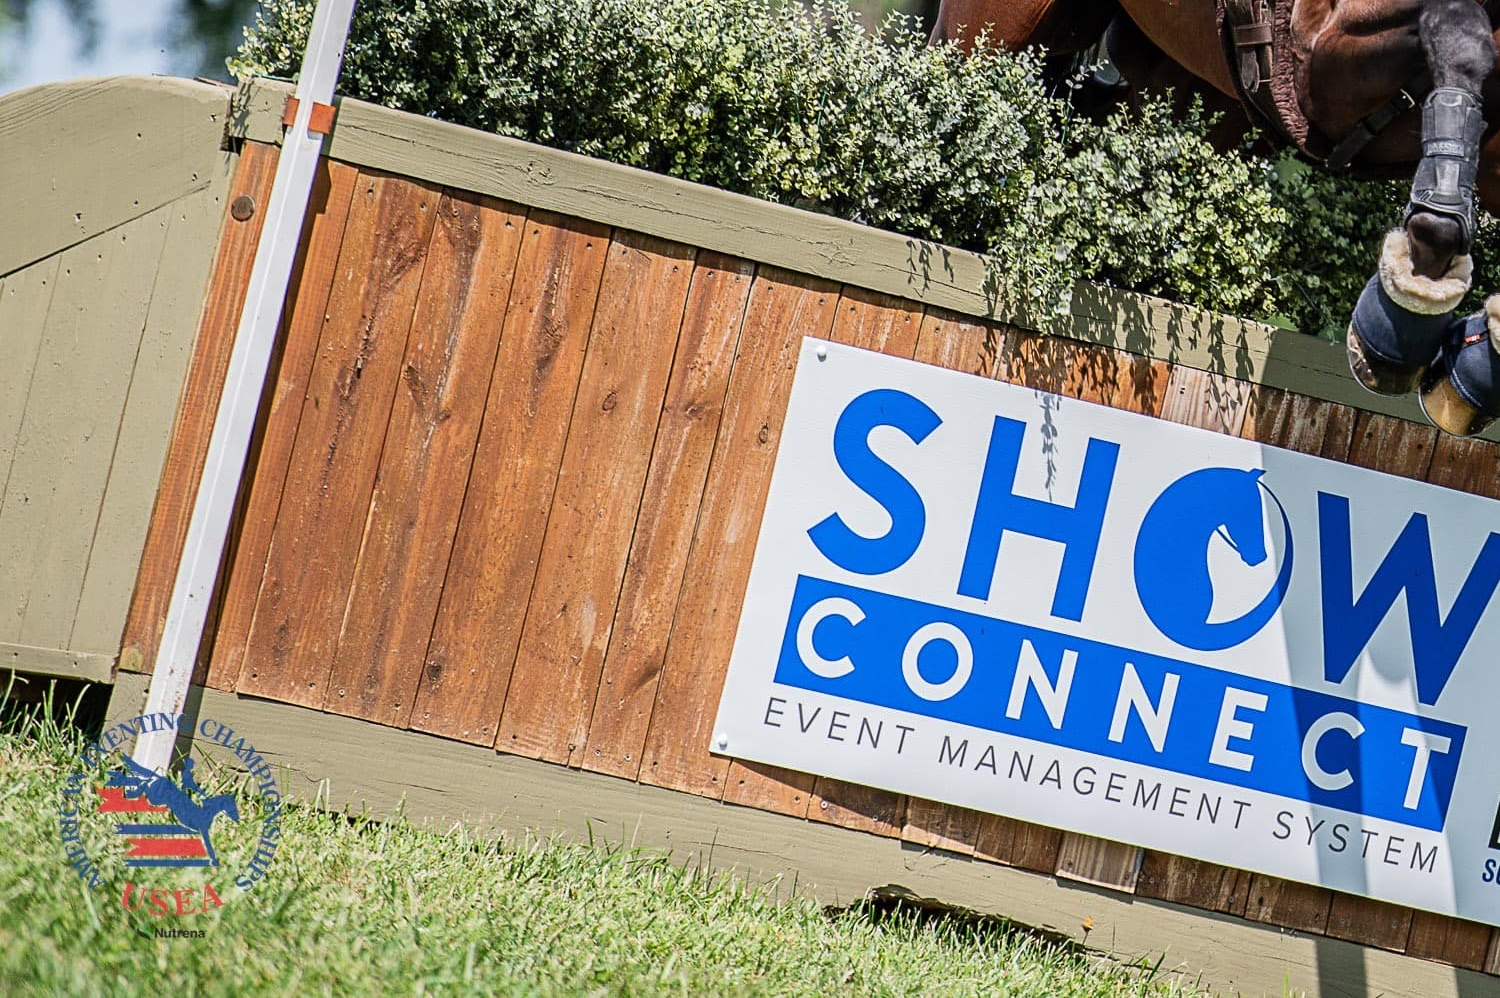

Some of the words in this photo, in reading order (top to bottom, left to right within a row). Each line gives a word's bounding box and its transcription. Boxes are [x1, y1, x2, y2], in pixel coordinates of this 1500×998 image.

[763, 697, 917, 756] EVENT
[938, 735, 1251, 830] MANAGEMENT
[1274, 810, 1440, 874] SYSTEM
[796, 596, 1452, 811] CONNECT
